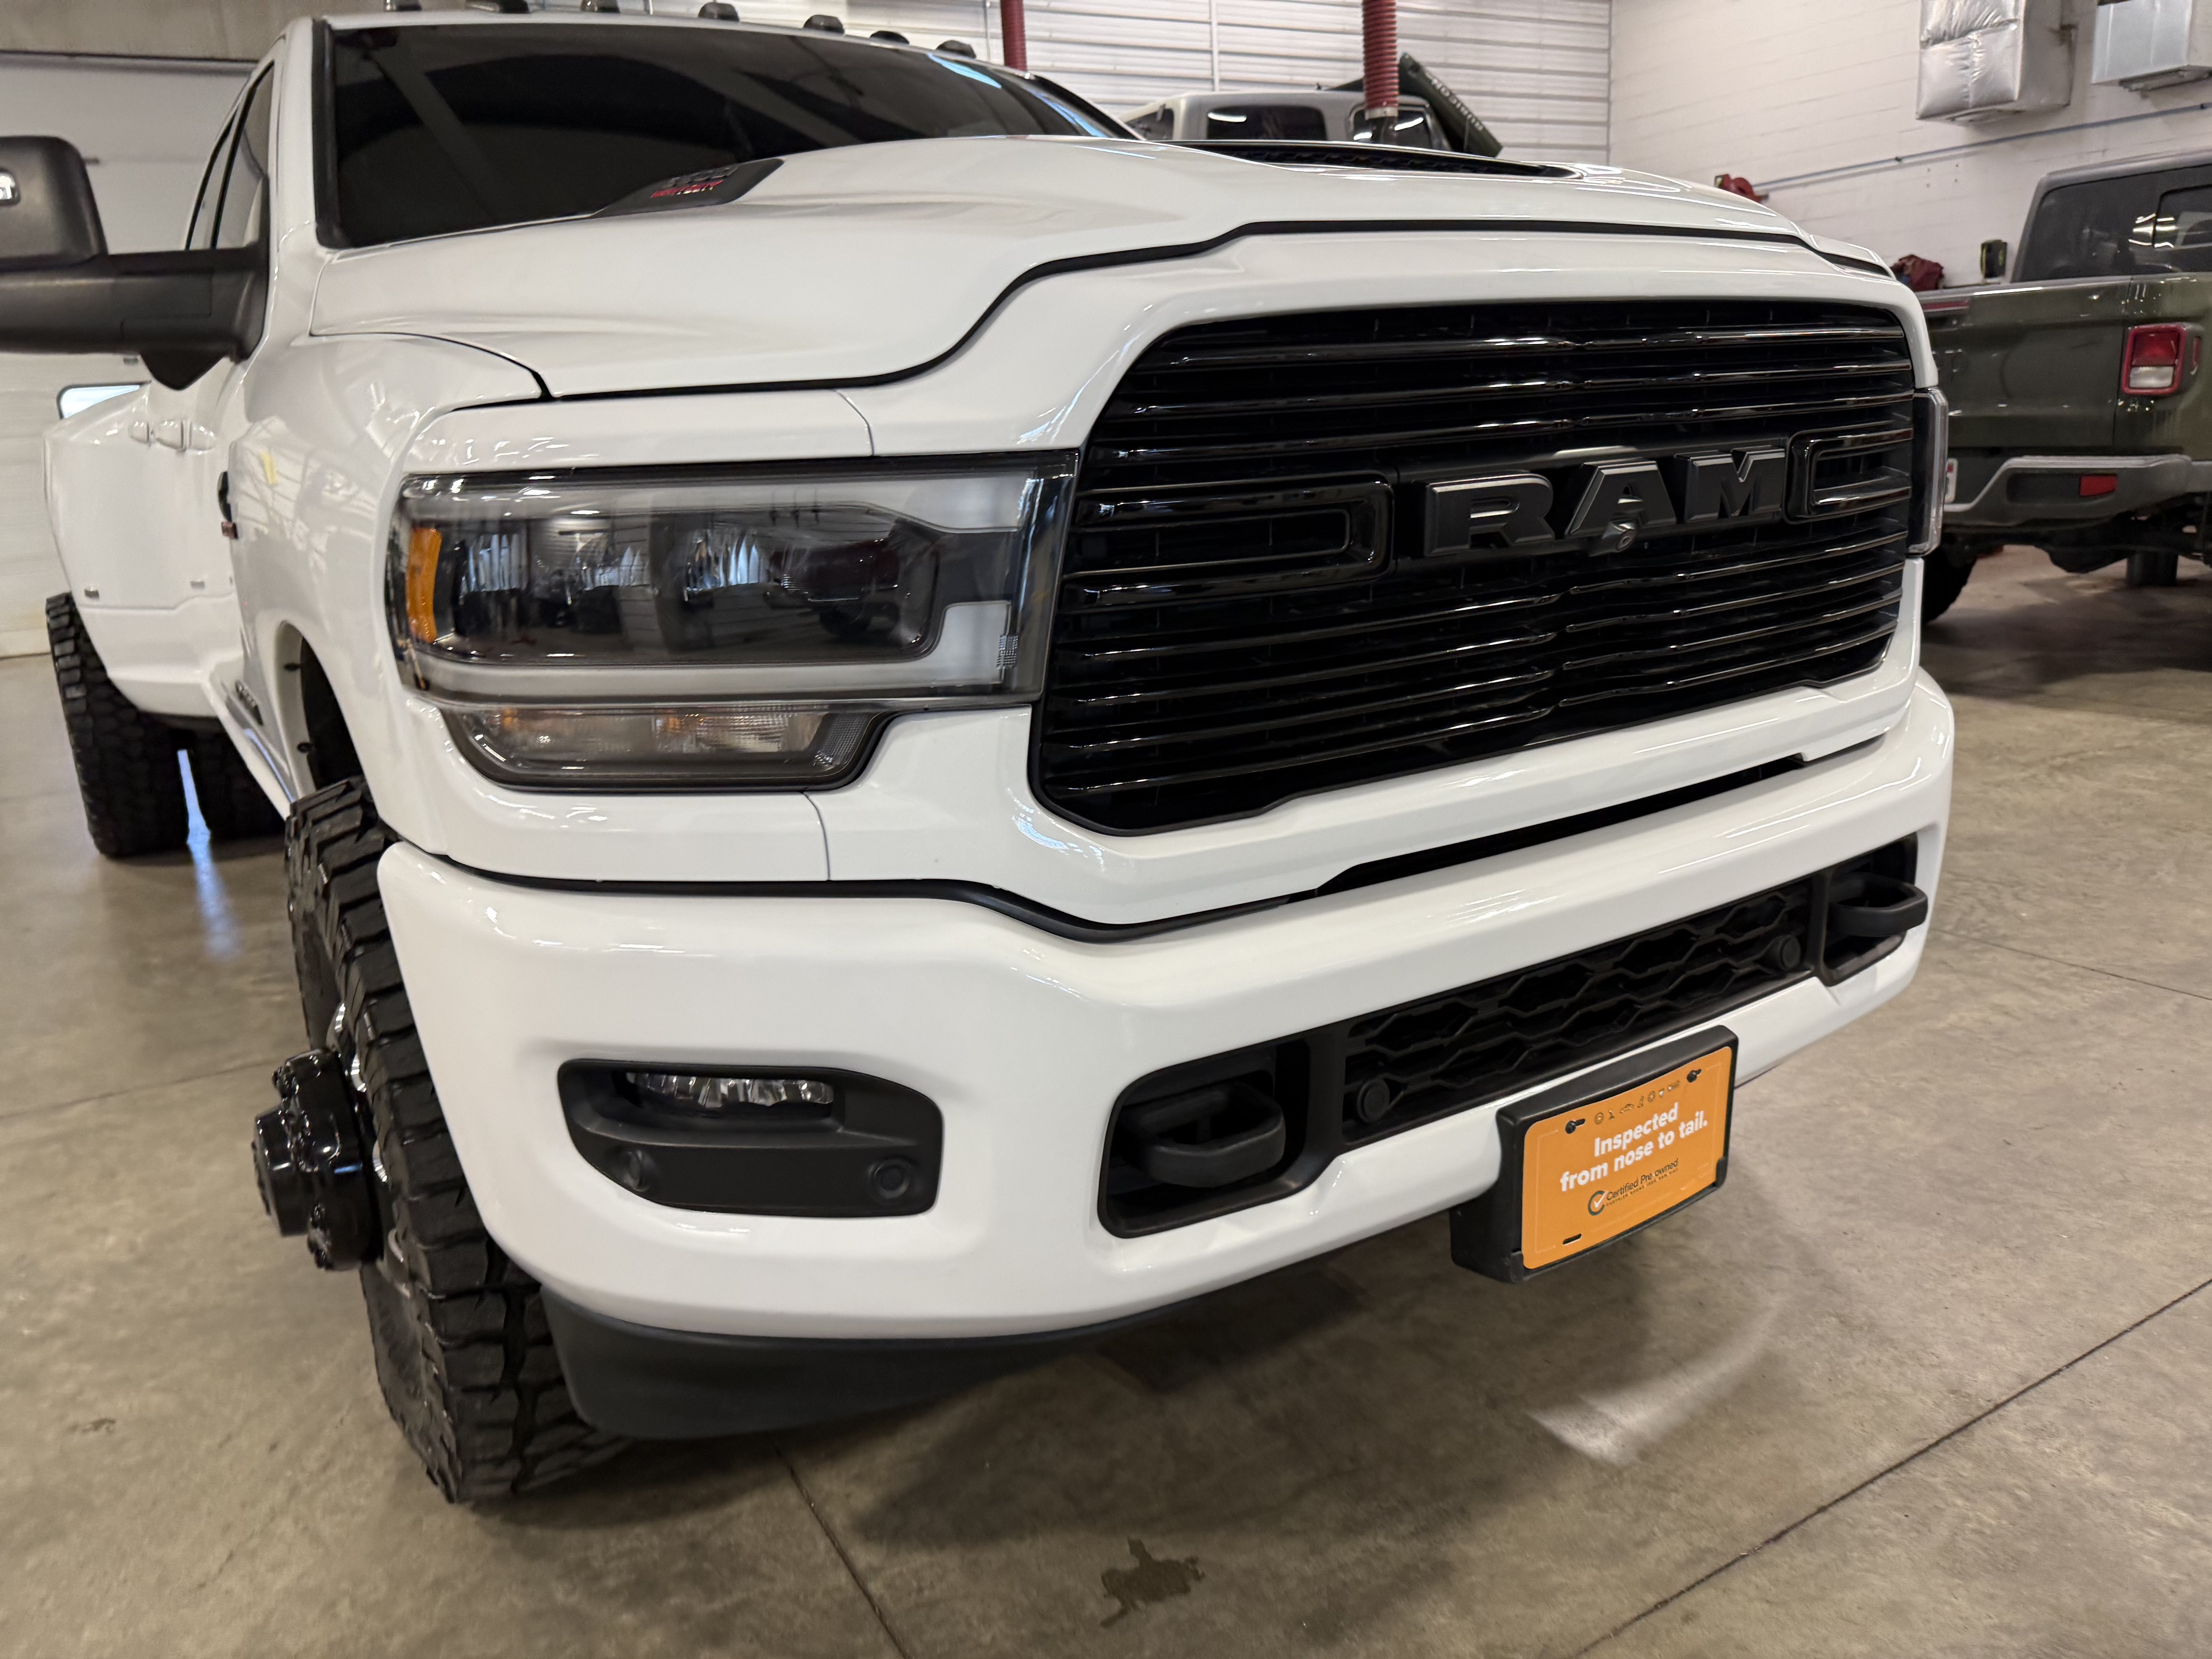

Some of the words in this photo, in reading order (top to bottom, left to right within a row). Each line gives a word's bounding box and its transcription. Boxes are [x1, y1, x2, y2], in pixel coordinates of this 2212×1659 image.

[1424, 445, 1786, 557] RAM
[1560, 1162, 1609, 1192] from
[1614, 1141, 1654, 1172] nose
[1658, 1130, 1675, 1149] to
[1679, 1110, 1708, 1139] tail.
[1594, 1101, 1678, 1157] Inspected
[1607, 1176, 1639, 1201] Certified
